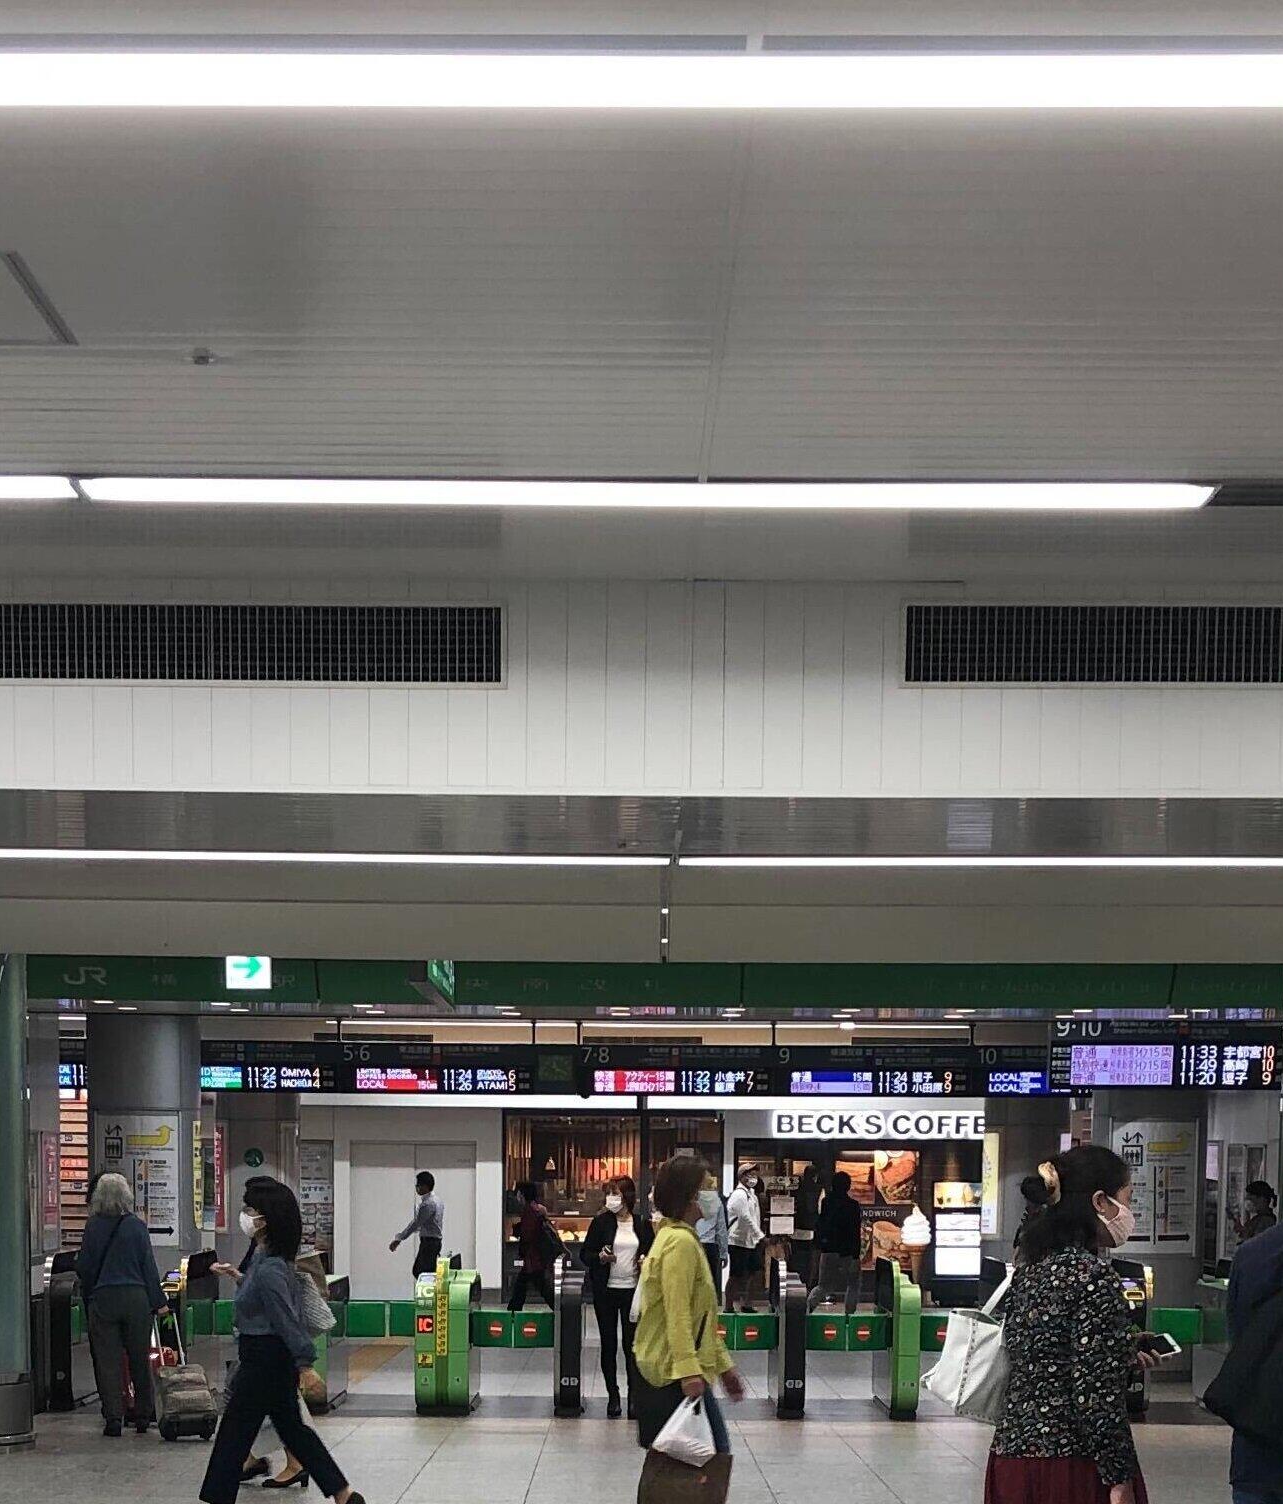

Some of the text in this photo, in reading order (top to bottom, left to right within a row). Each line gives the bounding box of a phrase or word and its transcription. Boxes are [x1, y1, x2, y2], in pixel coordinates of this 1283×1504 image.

[63, 966, 107, 986] JR
[778, 1048, 790, 1064] 9
[1181, 1046, 1218, 1059] 11:33
[1223, 1047, 1262, 1059] 宇都宮
[1263, 1046, 1275, 1058] 10
[1180, 1059, 1217, 1072] 11:49
[1262, 1060, 1274, 1072] 10
[247, 1066, 277, 1078] 11:22
[443, 1069, 473, 1080] 11:24
[681, 1070, 711, 1082] 11:22
[714, 1071, 746, 1083] 小金井
[746, 1071, 754, 1082] 7
[878, 1071, 908, 1082] 11:24
[943, 1071, 953, 1083] 9
[989, 1073, 1020, 1082] LOCAL
[247, 1077, 277, 1088] 11:25
[1179, 1073, 1217, 1085] 11:20
[1261, 1073, 1272, 1085] 9
[356, 1080, 388, 1089] LOCAL
[443, 1080, 473, 1091] 11:26
[476, 1081, 508, 1090] ATAMI
[681, 1082, 711, 1093] 11:32
[746, 1082, 754, 1093] 7
[878, 1083, 908, 1093] 11:30
[912, 1083, 944, 1093] 小田原
[943, 1083, 953, 1094] 9
[988, 1084, 1019, 1092] LOCAL
[417, 1286, 435, 1298] IC
[419, 1317, 433, 1332] IC
